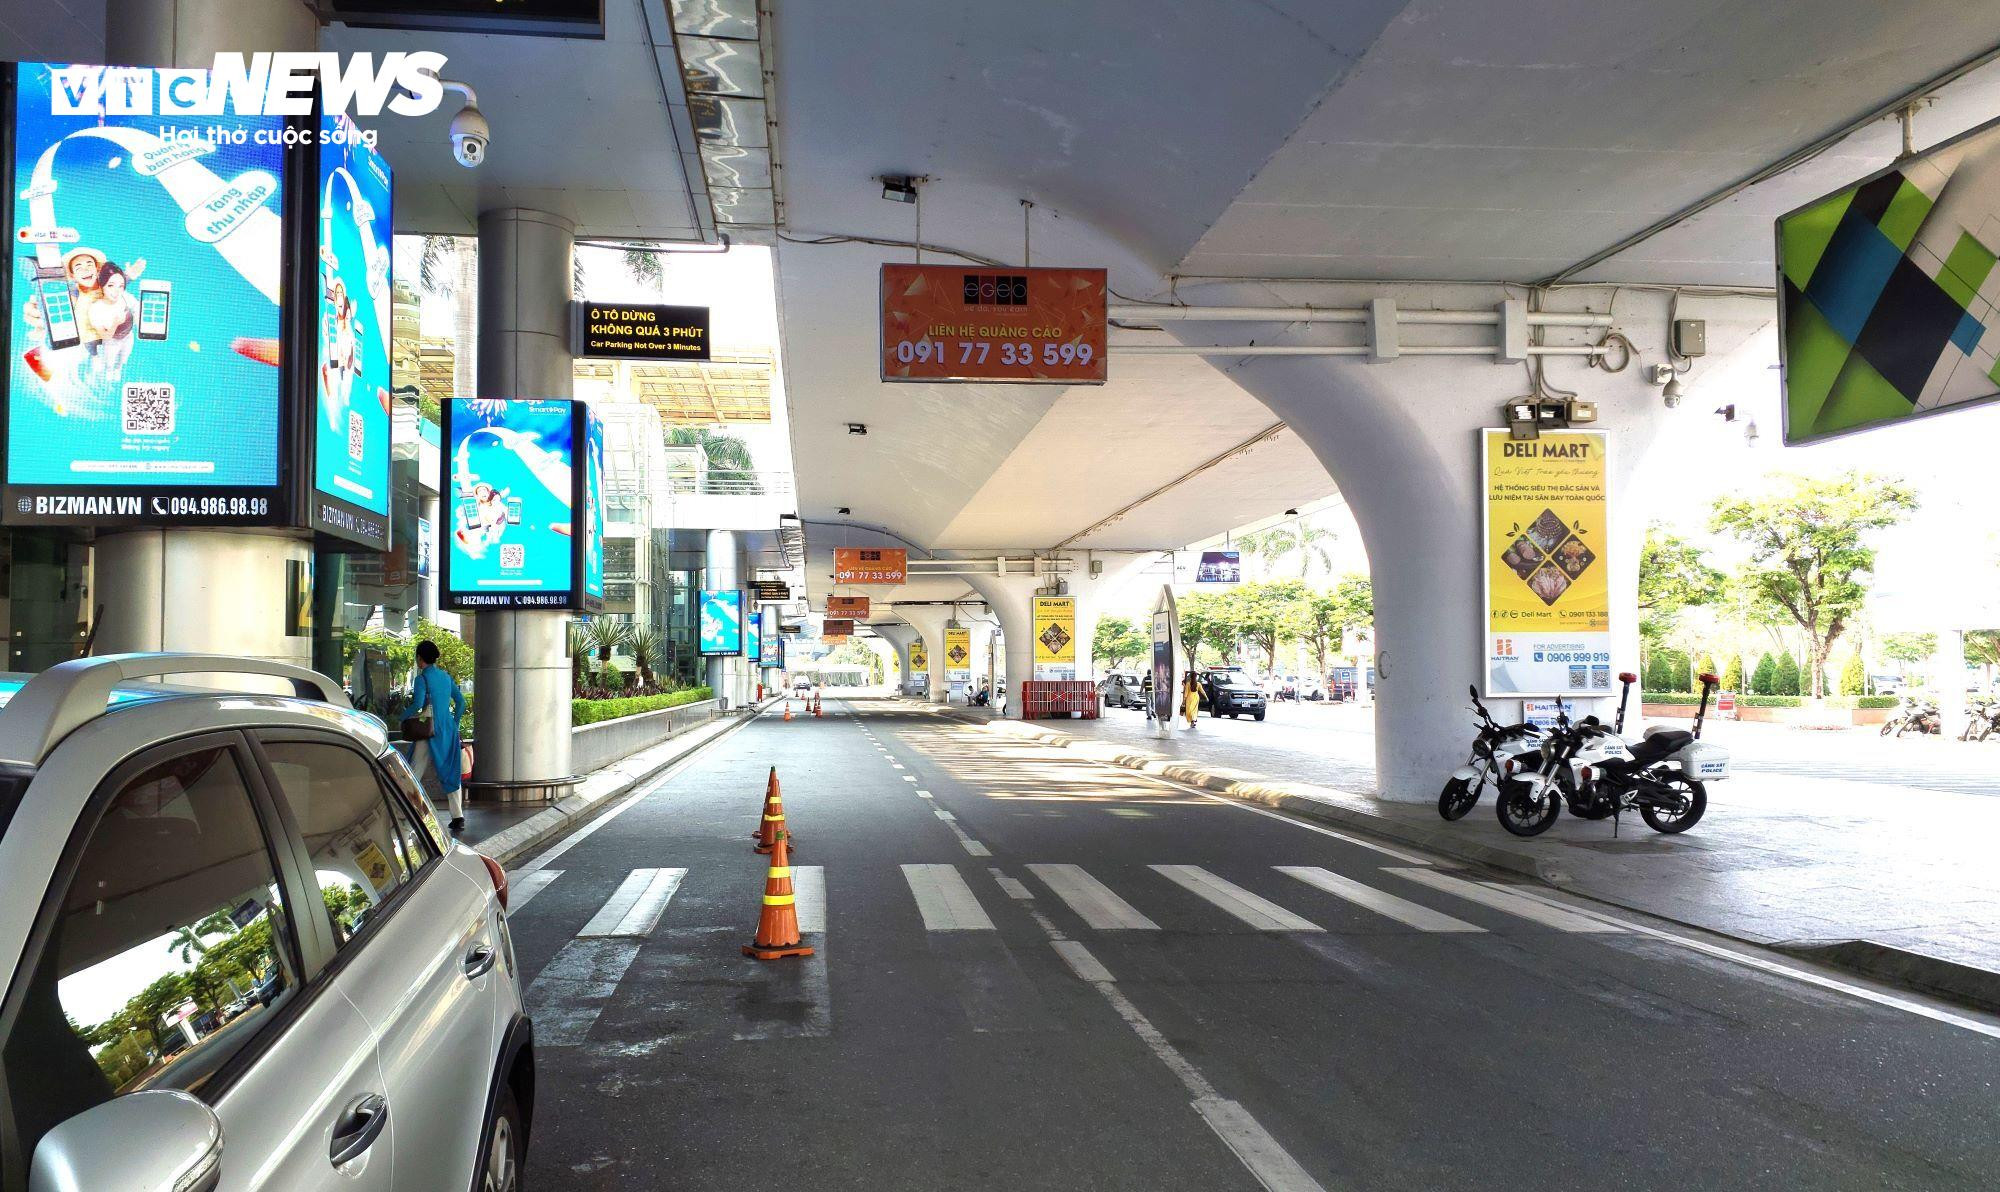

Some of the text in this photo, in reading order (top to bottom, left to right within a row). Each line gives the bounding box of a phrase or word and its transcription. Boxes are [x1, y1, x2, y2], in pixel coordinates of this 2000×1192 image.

[591, 308, 656, 322] Ô TÔ DỪNG
[591, 323, 703, 338] KHÔNG QUÁ 3 PHÚT
[928, 323, 1062, 340] LIÊN HỆ QUẢNG CÁO
[605, 341, 632, 349] Parking
[897, 341, 1093, 366] 091 77 33 599
[1503, 442, 1590, 458] DELI MART
[35, 496, 268, 515] BIZMAN.VN 094.986.98.98
[462, 596, 510, 605] BIZMAN.VN
[1547, 652, 1610, 662] 0906 999 919
